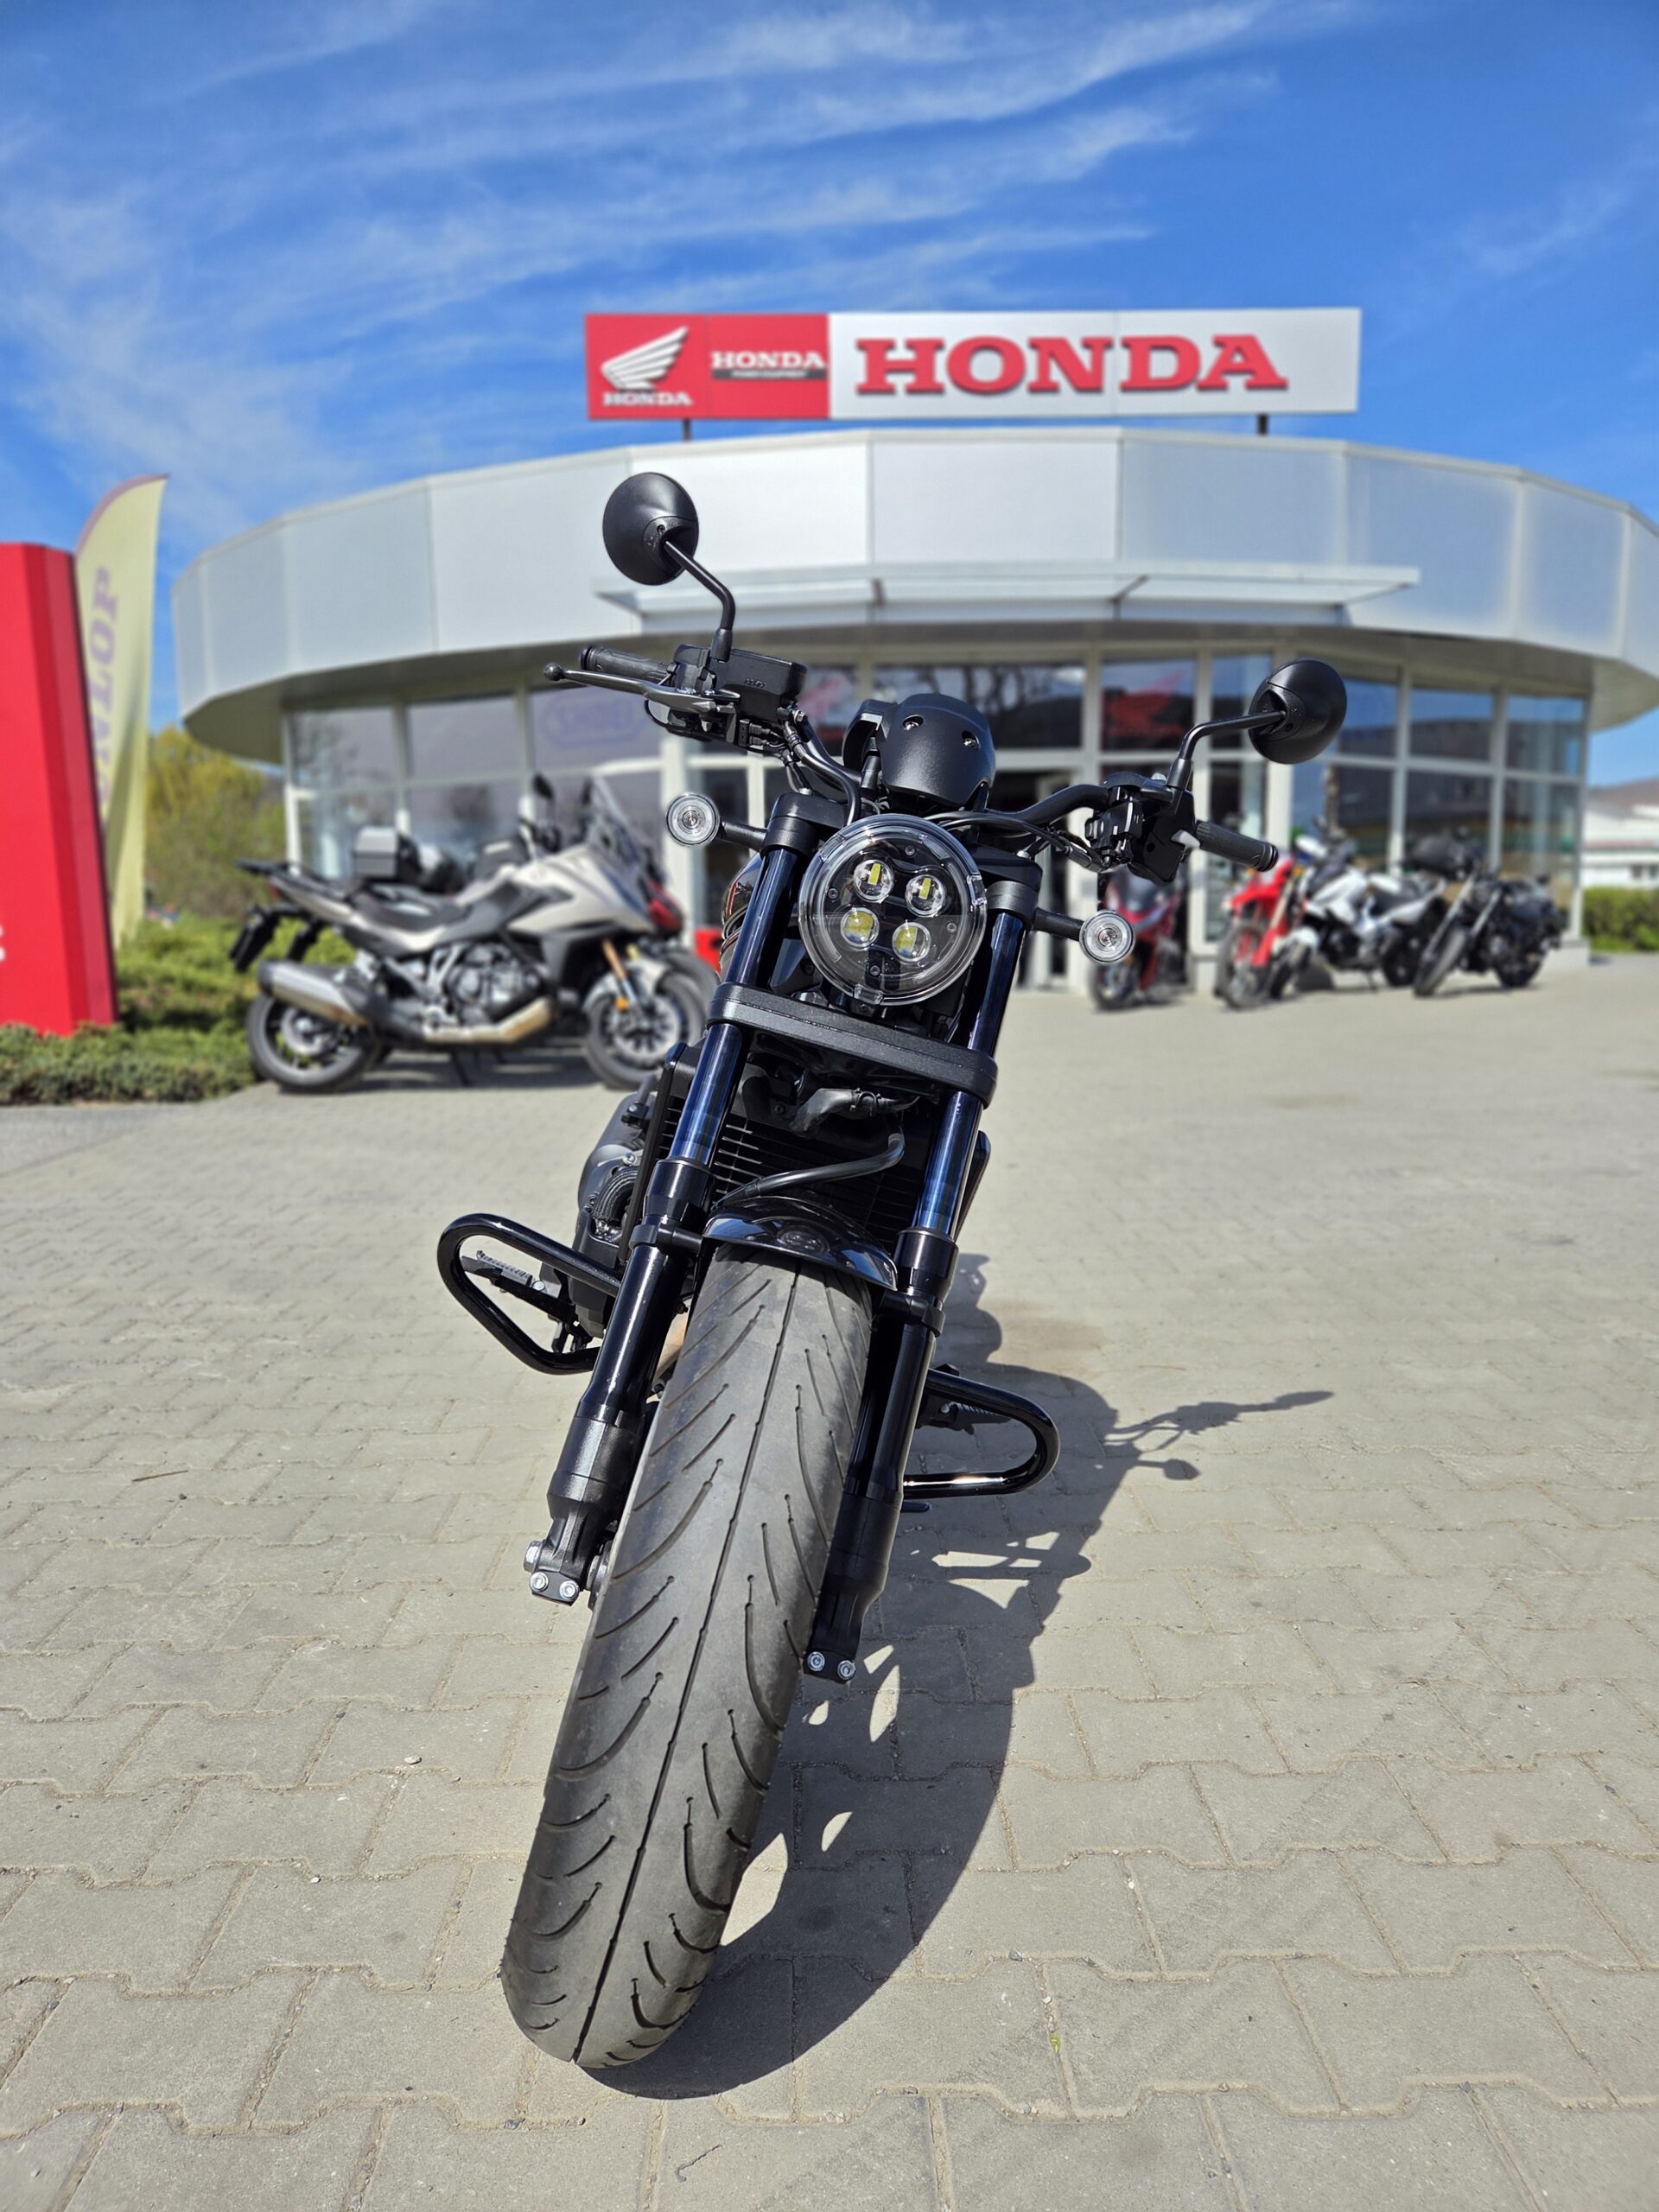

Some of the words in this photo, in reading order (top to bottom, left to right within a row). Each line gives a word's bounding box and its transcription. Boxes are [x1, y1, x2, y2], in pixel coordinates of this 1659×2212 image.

[709, 351, 827, 369] HONDA
[855, 334, 1288, 395] HONDA
[602, 391, 693, 406] HONDA
